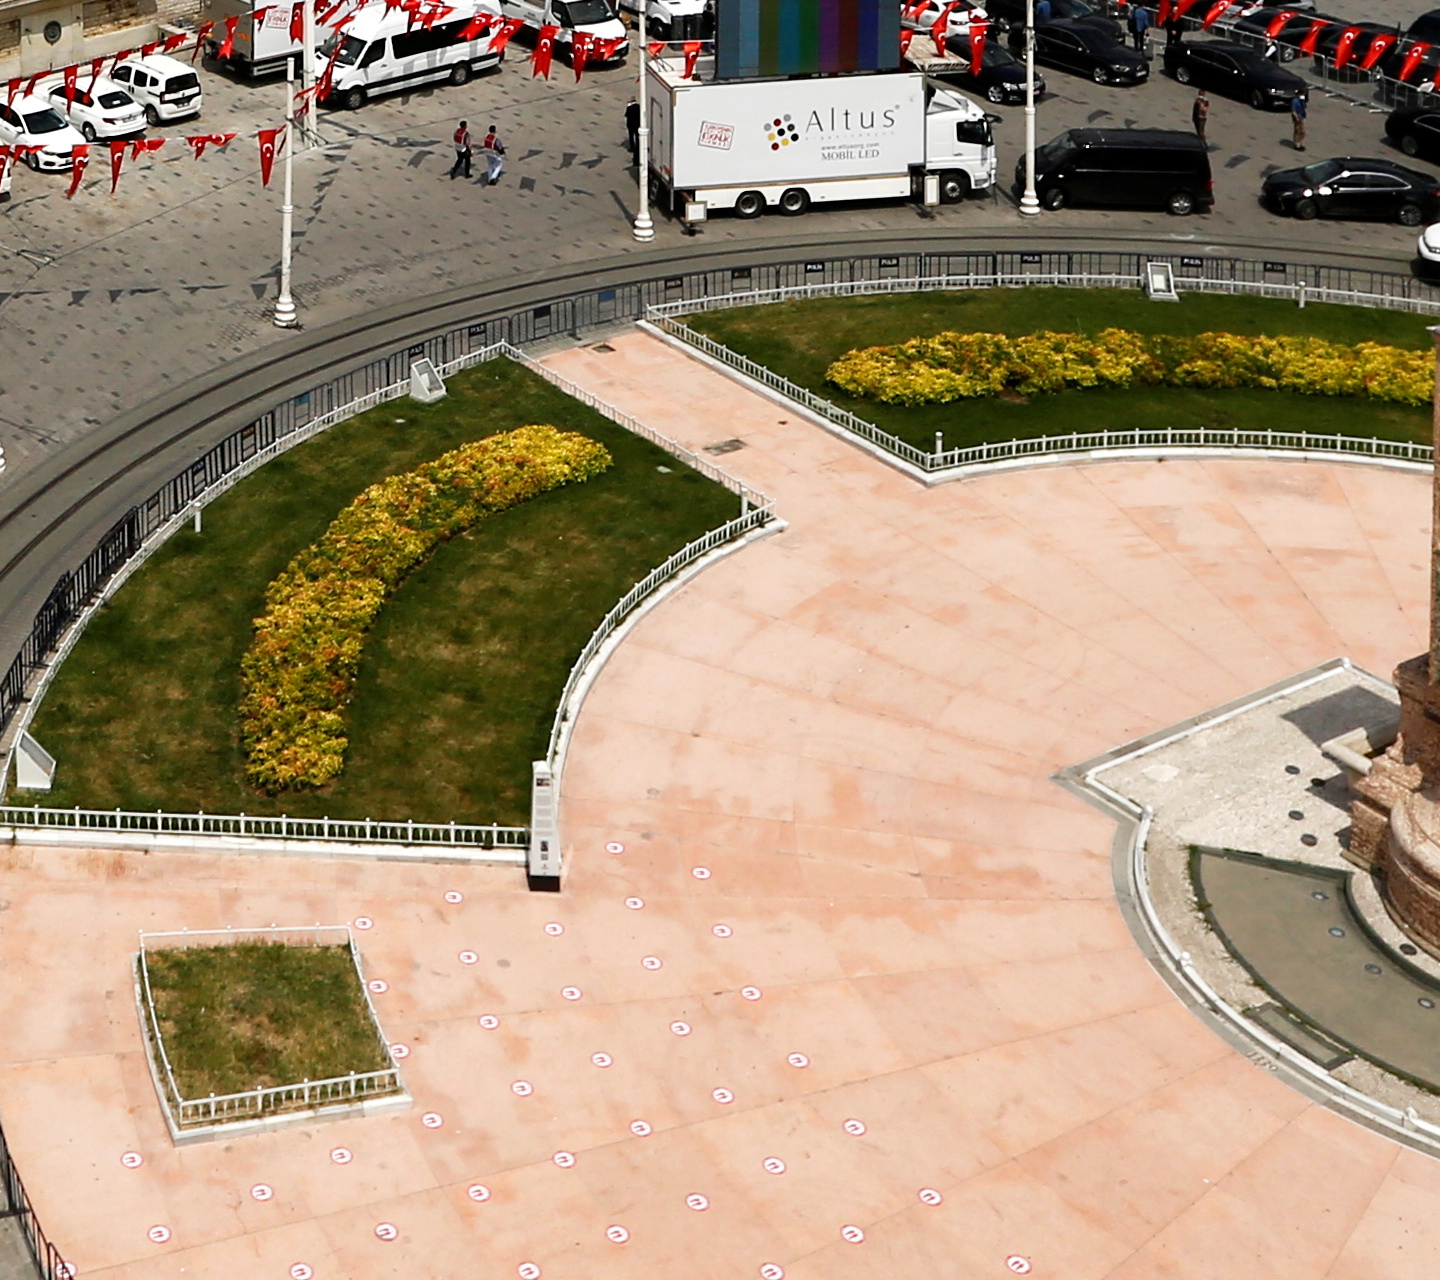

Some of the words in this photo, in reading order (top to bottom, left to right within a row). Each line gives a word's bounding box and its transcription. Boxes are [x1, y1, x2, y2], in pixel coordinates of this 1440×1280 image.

[805, 107, 896, 133] Altus
[821, 149, 857, 161] MOBİL
[858, 148, 880, 159] LED
